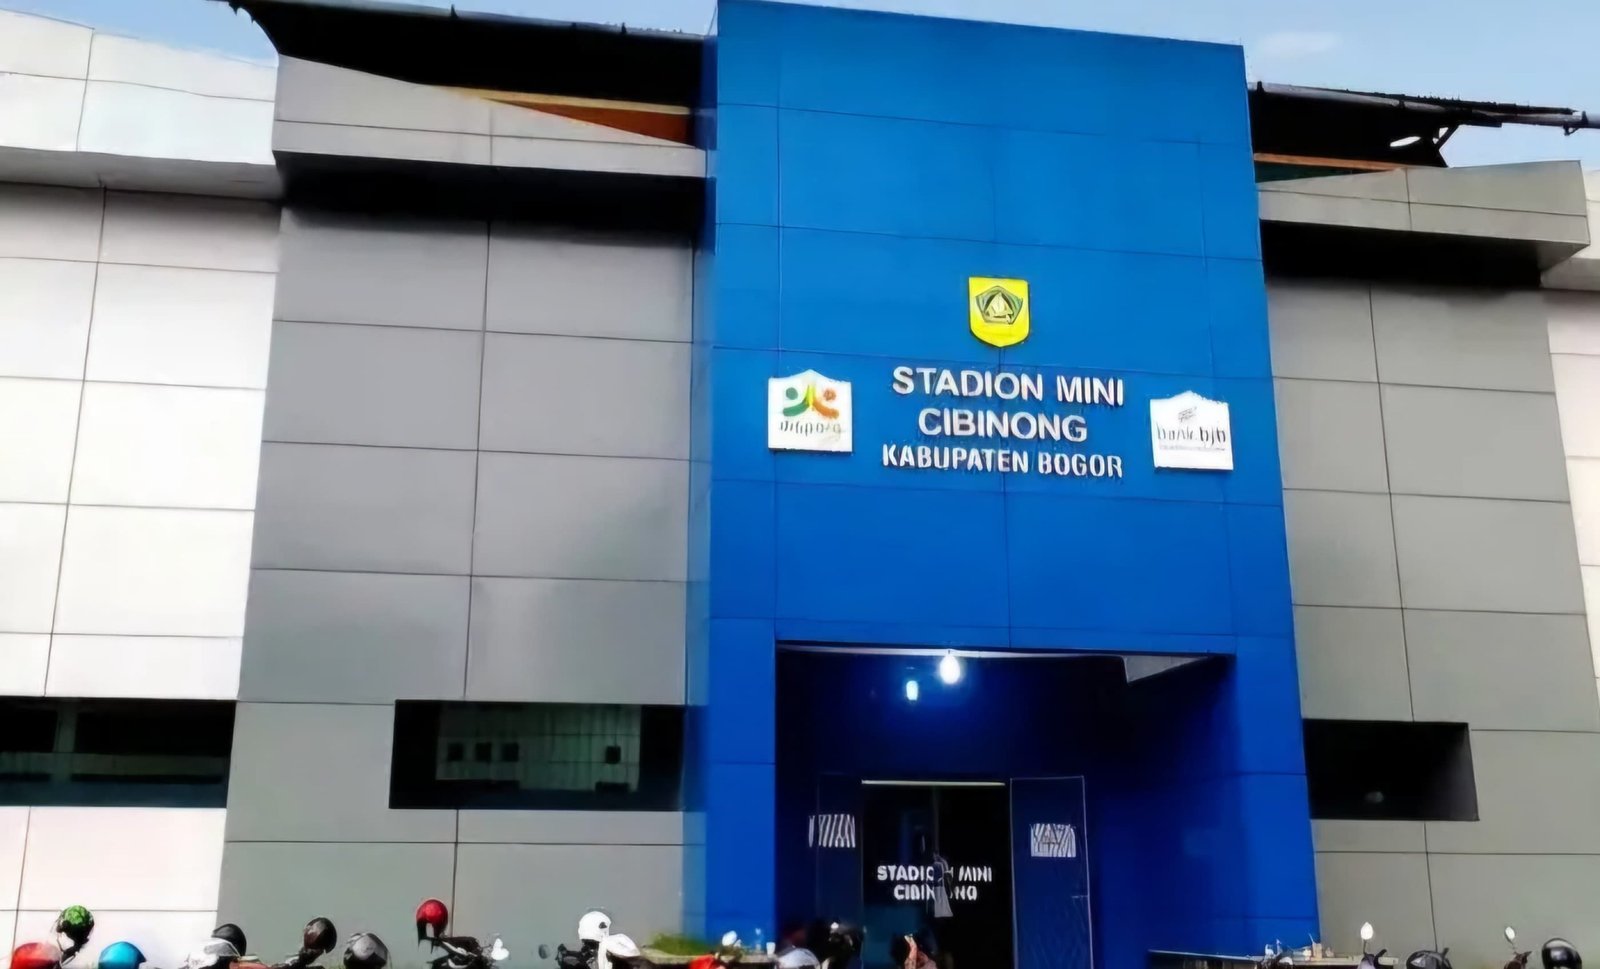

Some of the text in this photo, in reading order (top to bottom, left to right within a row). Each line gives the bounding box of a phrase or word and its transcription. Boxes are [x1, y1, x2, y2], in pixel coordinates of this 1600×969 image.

[892, 366, 1124, 407] STADION MINI
[918, 407, 1088, 443] CIBINONG
[882, 442, 1123, 479] KABUPATEN BOGOR
[958, 865, 992, 882] MINI
[893, 883, 978, 901] CIBINNG
